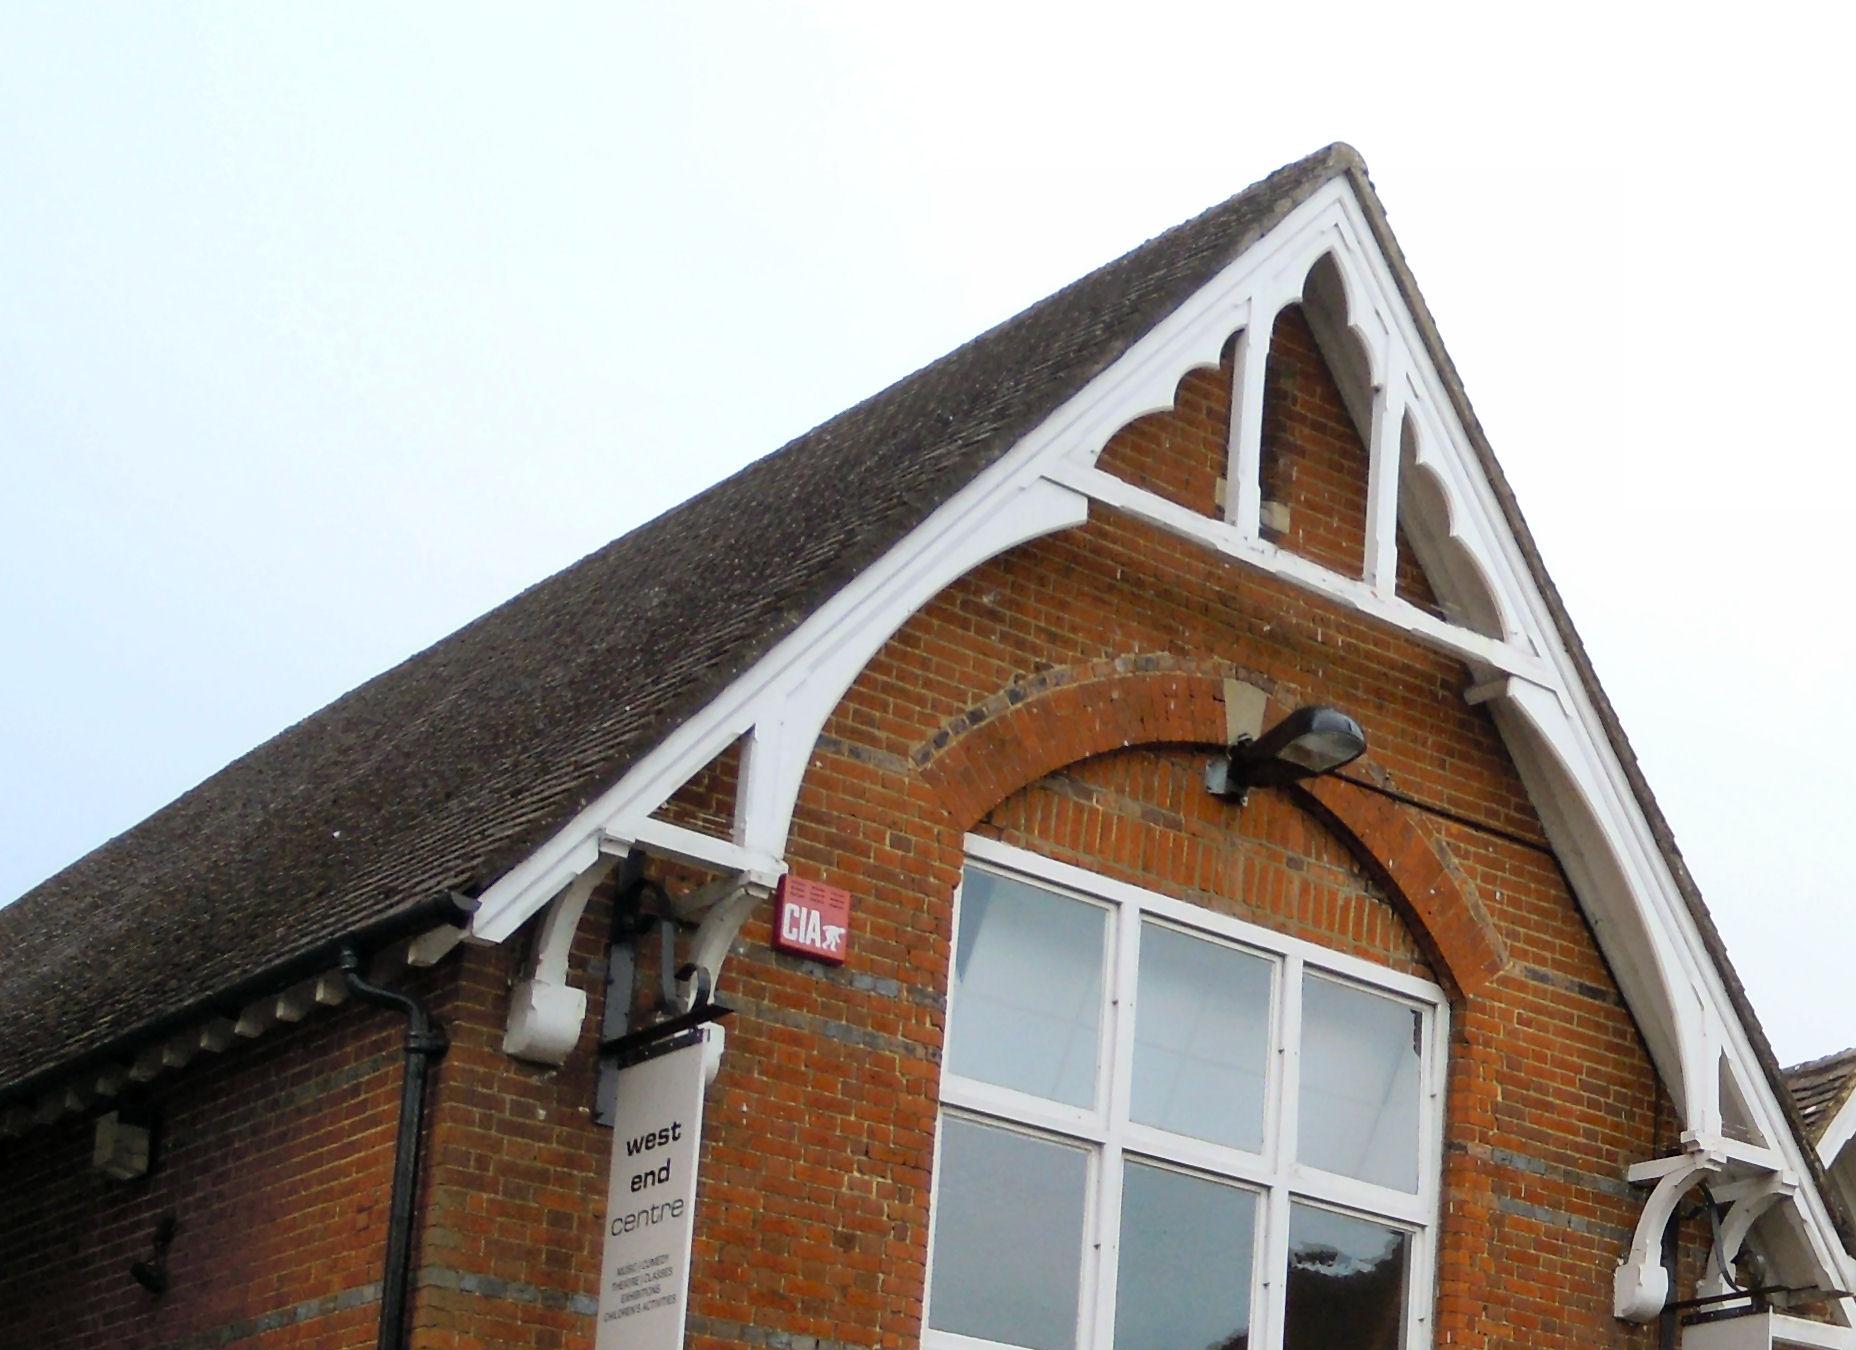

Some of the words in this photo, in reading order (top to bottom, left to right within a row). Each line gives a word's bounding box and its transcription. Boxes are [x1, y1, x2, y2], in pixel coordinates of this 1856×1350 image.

[782, 902, 821, 948] CIA
[626, 1121, 682, 1157] west
[630, 1158, 672, 1193] end
[610, 1198, 684, 1237] centre
